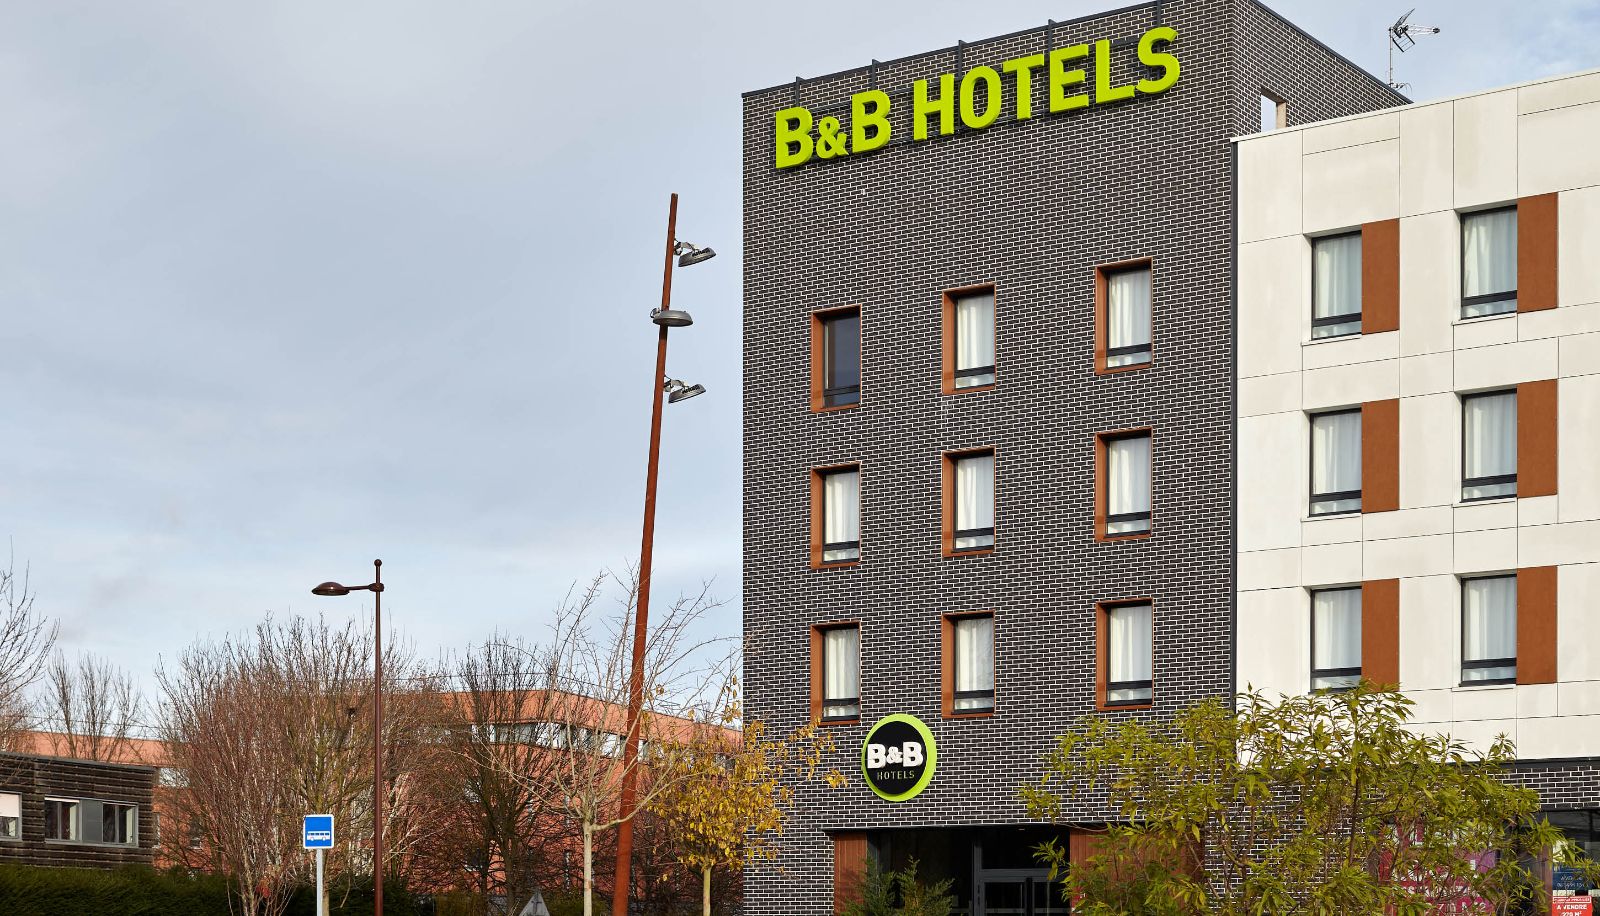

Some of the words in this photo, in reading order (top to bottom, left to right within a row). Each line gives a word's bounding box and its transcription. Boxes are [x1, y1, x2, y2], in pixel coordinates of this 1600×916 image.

[775, 89, 892, 169] B&B
[913, 26, 1181, 140] HOTELS
[867, 741, 924, 769] B&B
[877, 770, 915, 780] HOTELS
